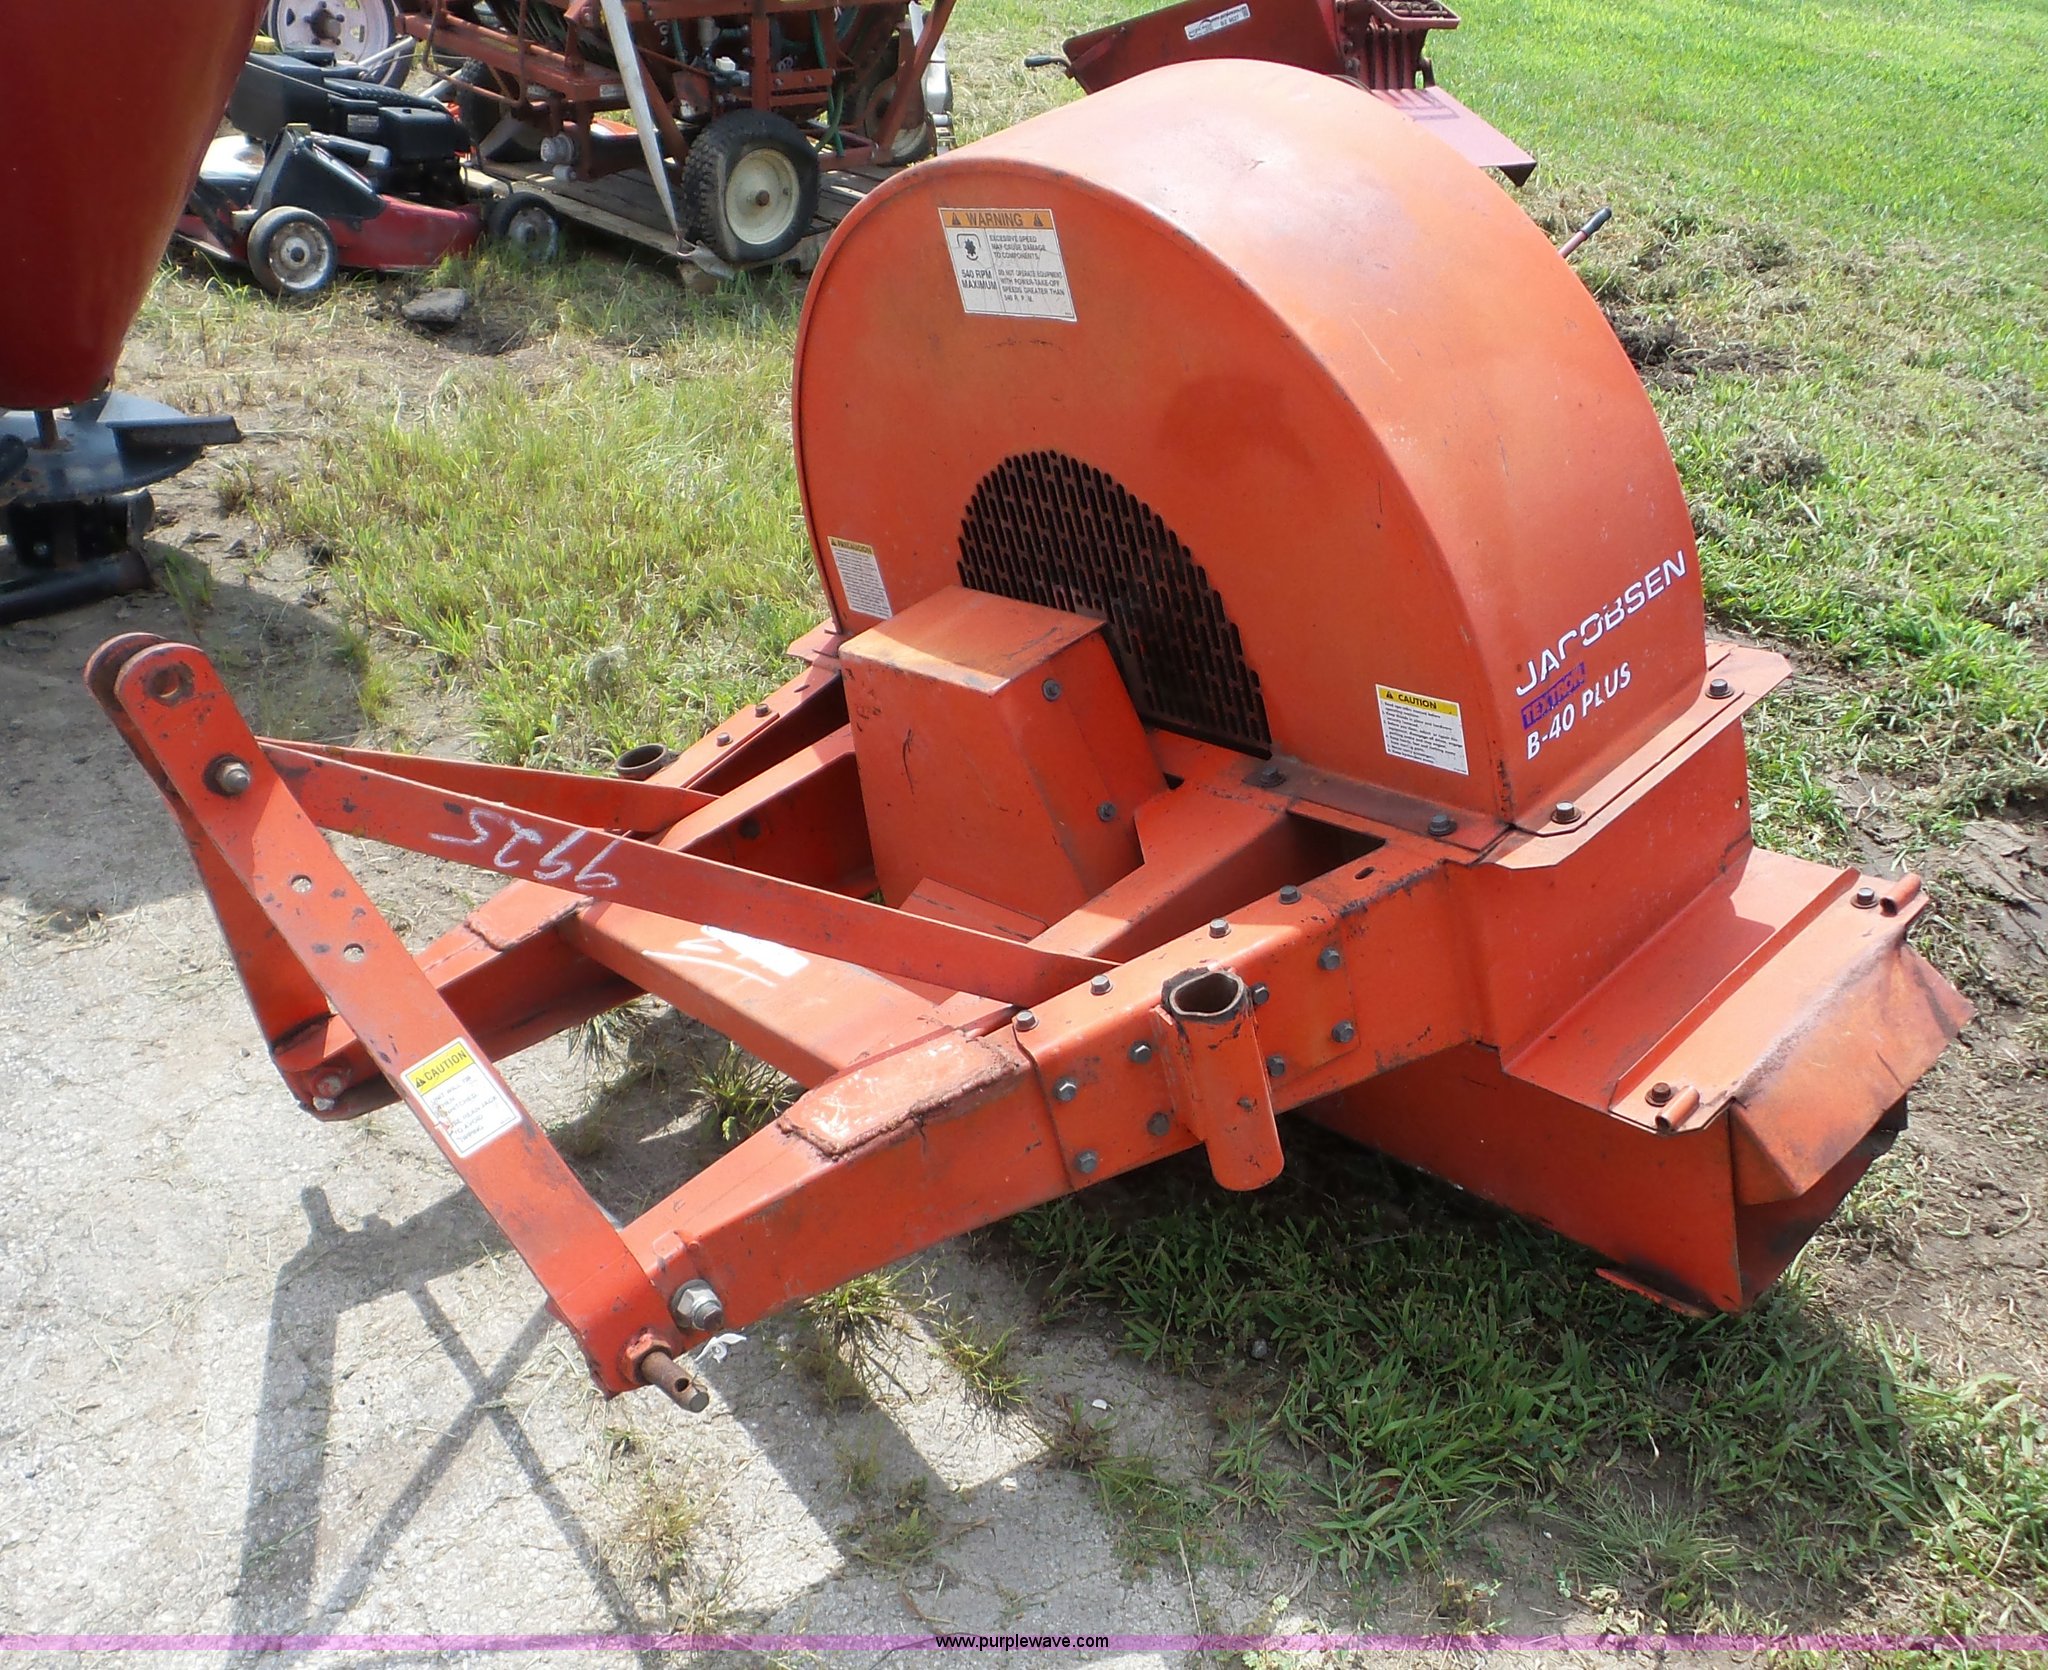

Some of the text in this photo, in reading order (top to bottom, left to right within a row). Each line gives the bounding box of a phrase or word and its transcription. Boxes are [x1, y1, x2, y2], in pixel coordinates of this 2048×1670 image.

[966, 212, 1024, 226] WARNING
[962, 269, 992, 279] 540 RPM
[962, 280, 998, 290] MAXIMUM
[1516, 550, 1687, 696] JACOBSEN
[1398, 694, 1437, 709] CAUTION
[1527, 662, 1632, 760] B-40 PLUS
[424, 1050, 467, 1081] CAUTION
